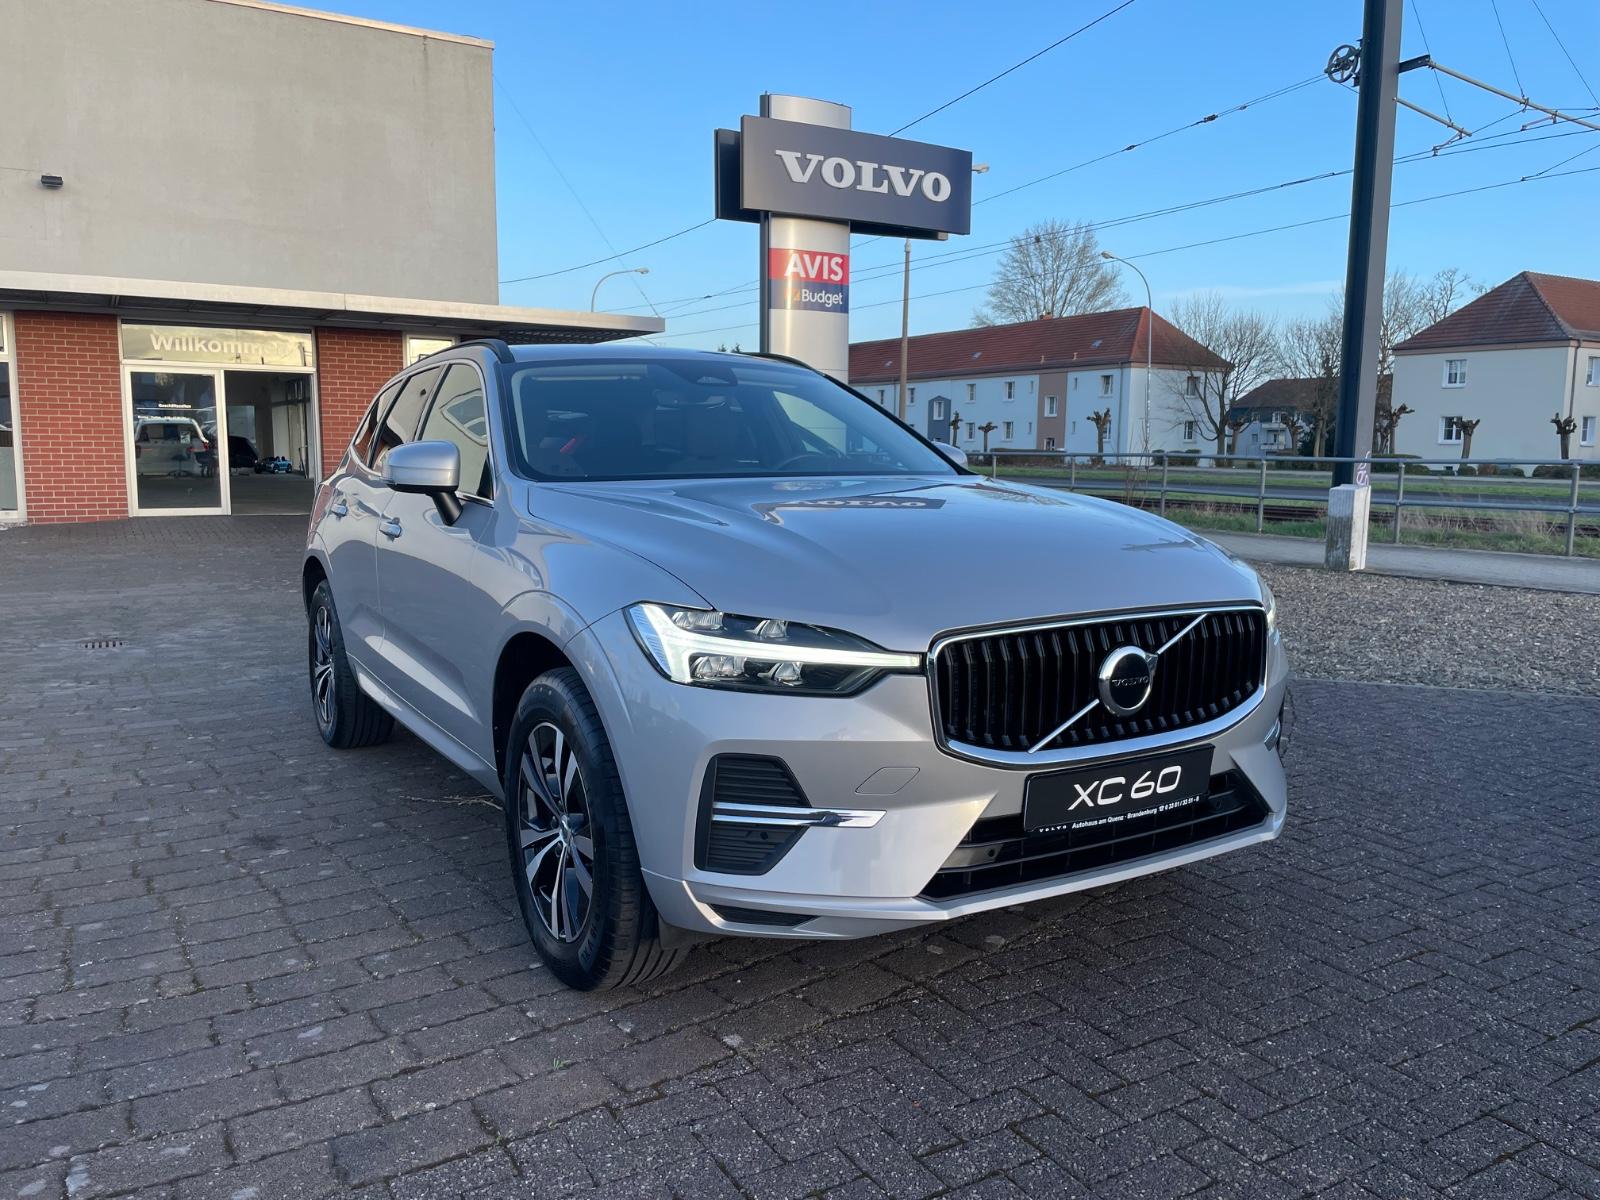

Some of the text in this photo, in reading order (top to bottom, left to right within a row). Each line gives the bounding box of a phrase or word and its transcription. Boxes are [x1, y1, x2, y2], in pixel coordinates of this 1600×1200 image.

[775, 150, 951, 202] VOLVO
[784, 253, 844, 282] AVIS
[801, 288, 843, 308] Budget
[150, 333, 288, 356] Willkomme
[1067, 765, 1182, 811] XC 60
[1071, 820, 1098, 829] Autohaus
[1127, 808, 1158, 819] Brandenburg
